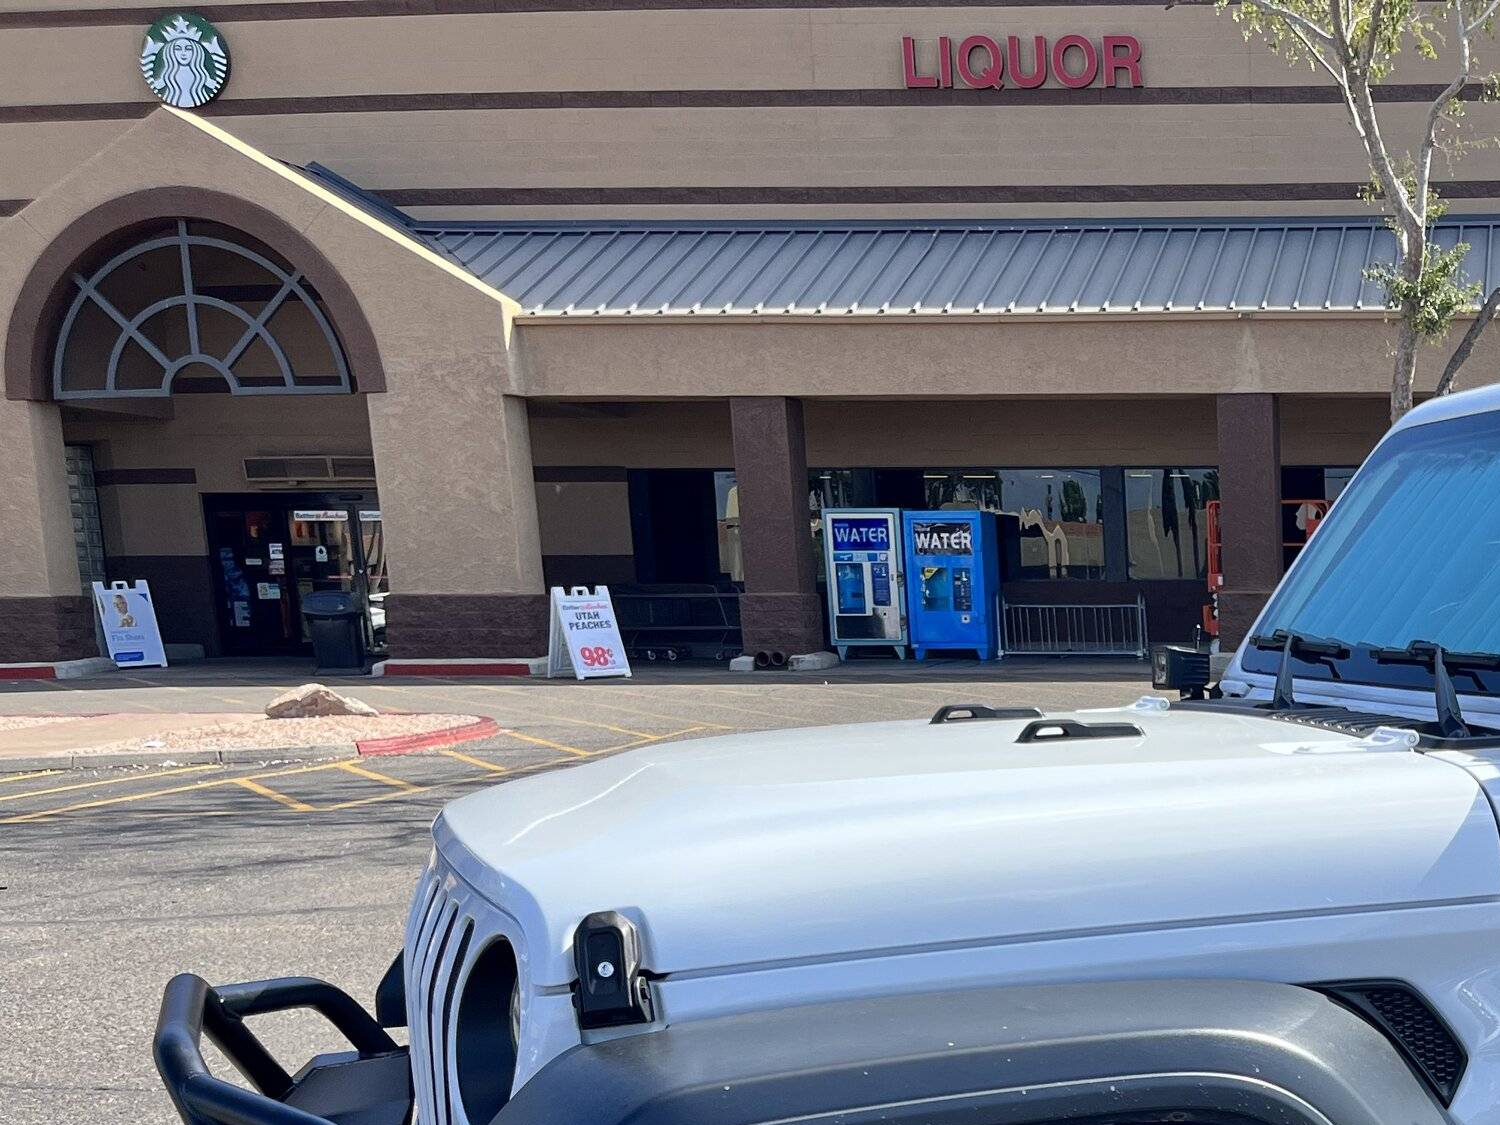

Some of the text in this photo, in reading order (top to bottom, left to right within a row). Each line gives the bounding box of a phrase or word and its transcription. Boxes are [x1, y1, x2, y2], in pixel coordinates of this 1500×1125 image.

[902, 34, 1143, 90] LIQUOR
[834, 527, 888, 543] WATER
[915, 531, 971, 549] WATER
[575, 611, 600, 621] UTAH
[569, 620, 612, 631] PEACHES
